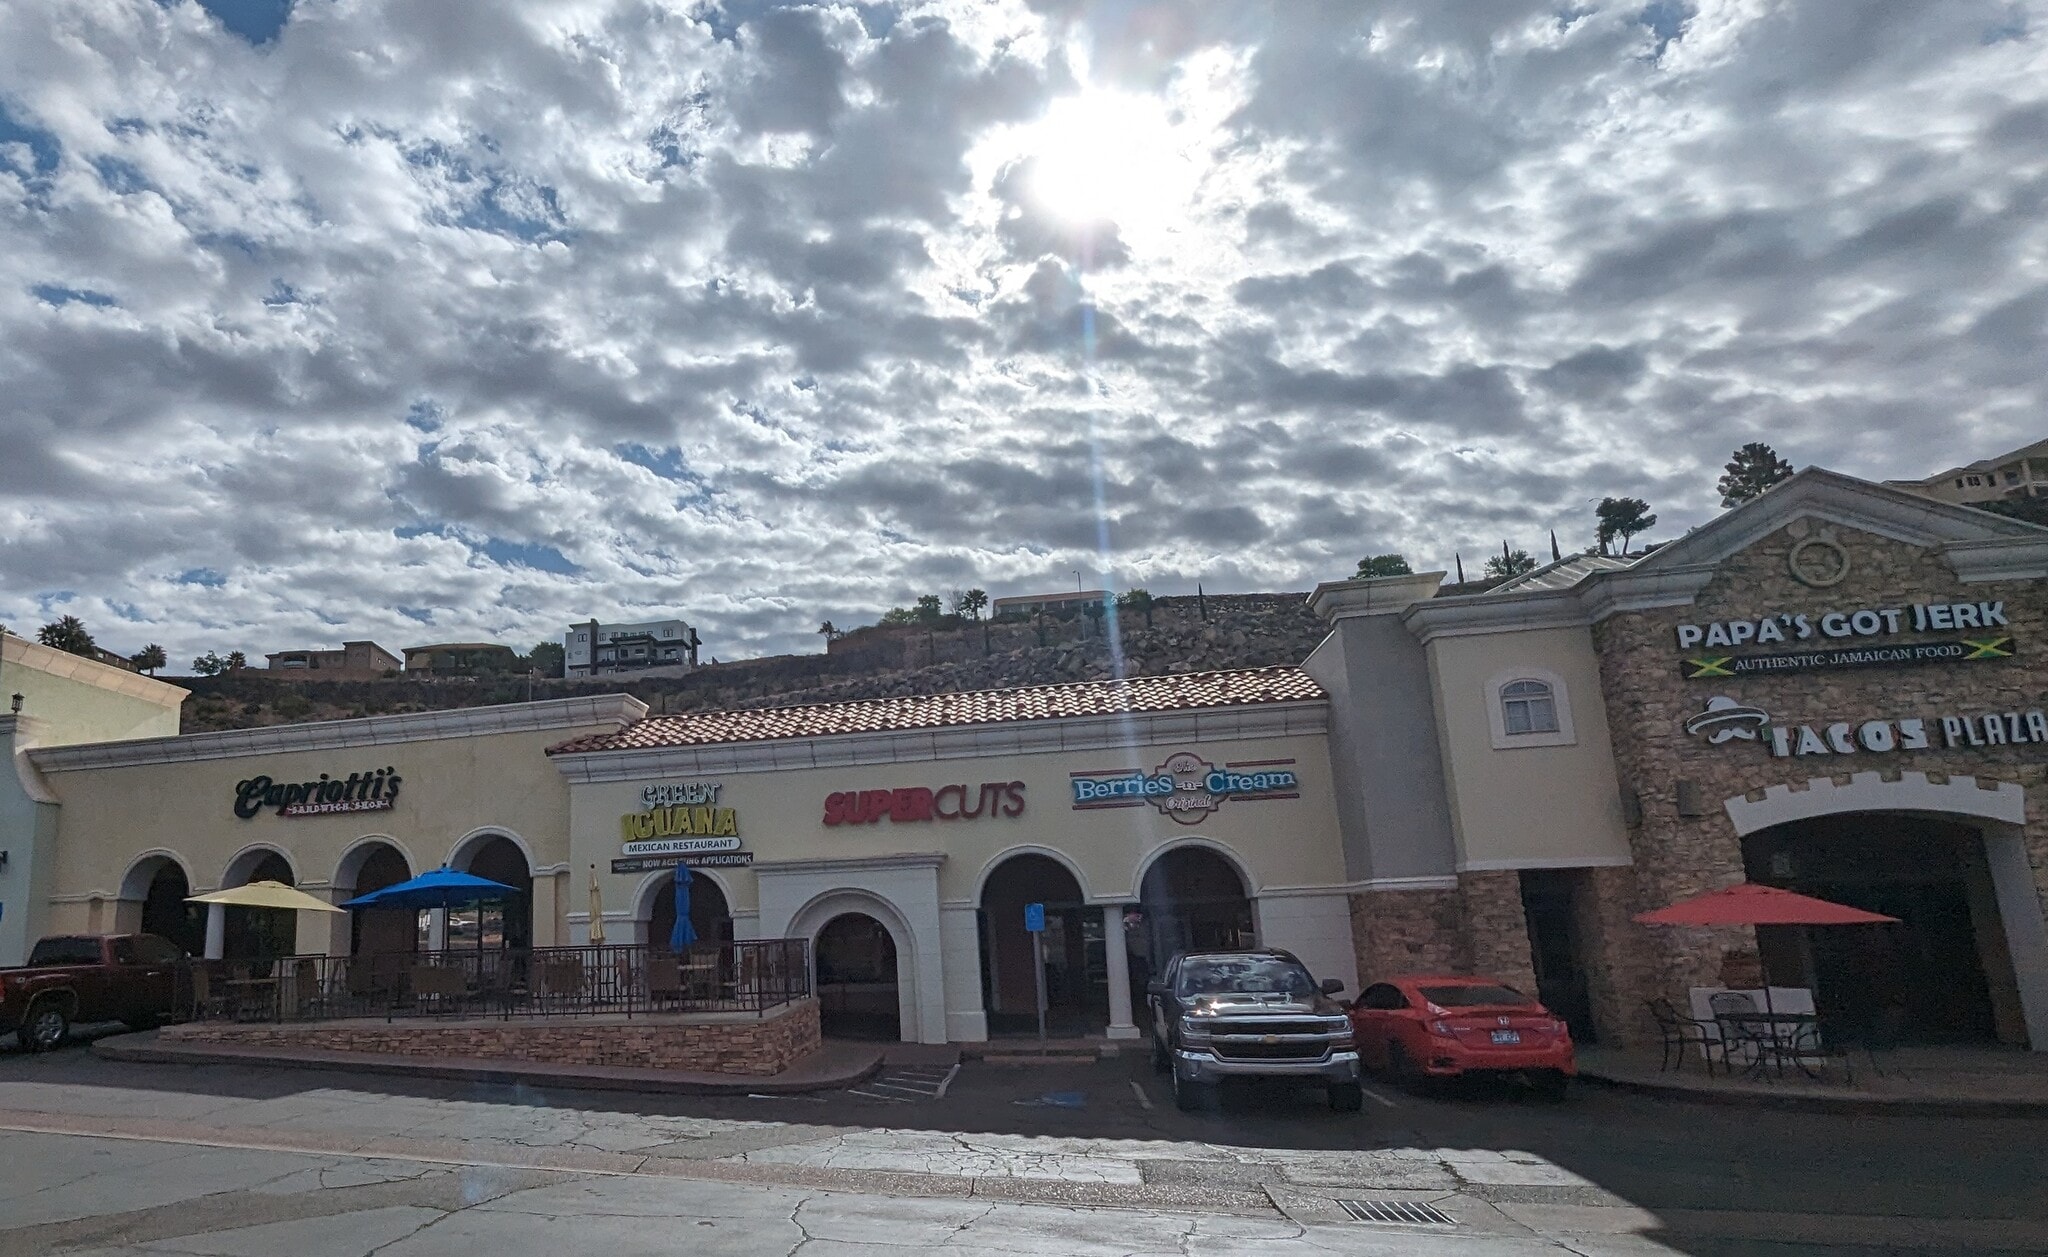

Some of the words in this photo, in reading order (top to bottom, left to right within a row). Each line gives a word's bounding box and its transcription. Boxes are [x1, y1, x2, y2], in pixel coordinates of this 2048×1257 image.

[1677, 614, 1811, 649] PAPA'S
[1821, 609, 1901, 638] GOT
[1912, 601, 2009, 633] JERK
[1735, 653, 1826, 671] AUTHENTIC
[1829, 648, 1911, 664] JAMAICAN
[1916, 645, 1963, 659] FOOD
[1763, 718, 1929, 757] TACOS
[1942, 708, 2048, 747] PLAZA
[234, 766, 402, 818] Capriotti's
[1205, 771, 1295, 793] Cream
[291, 802, 350, 814] SANDWICH
[354, 800, 385, 811] SHOP
[641, 783, 722, 809] GREEN
[823, 781, 1026, 826] SUPERCUTS
[1166, 794, 1212, 811] Original
[621, 806, 739, 842] IGUANA
[628, 842, 670, 853] MEXICAN
[673, 839, 733, 851] RESTAURANT
[642, 858, 660, 869] NOW
[662, 857, 700, 867] ACCEING
[701, 854, 752, 865] APPLICATIONS
